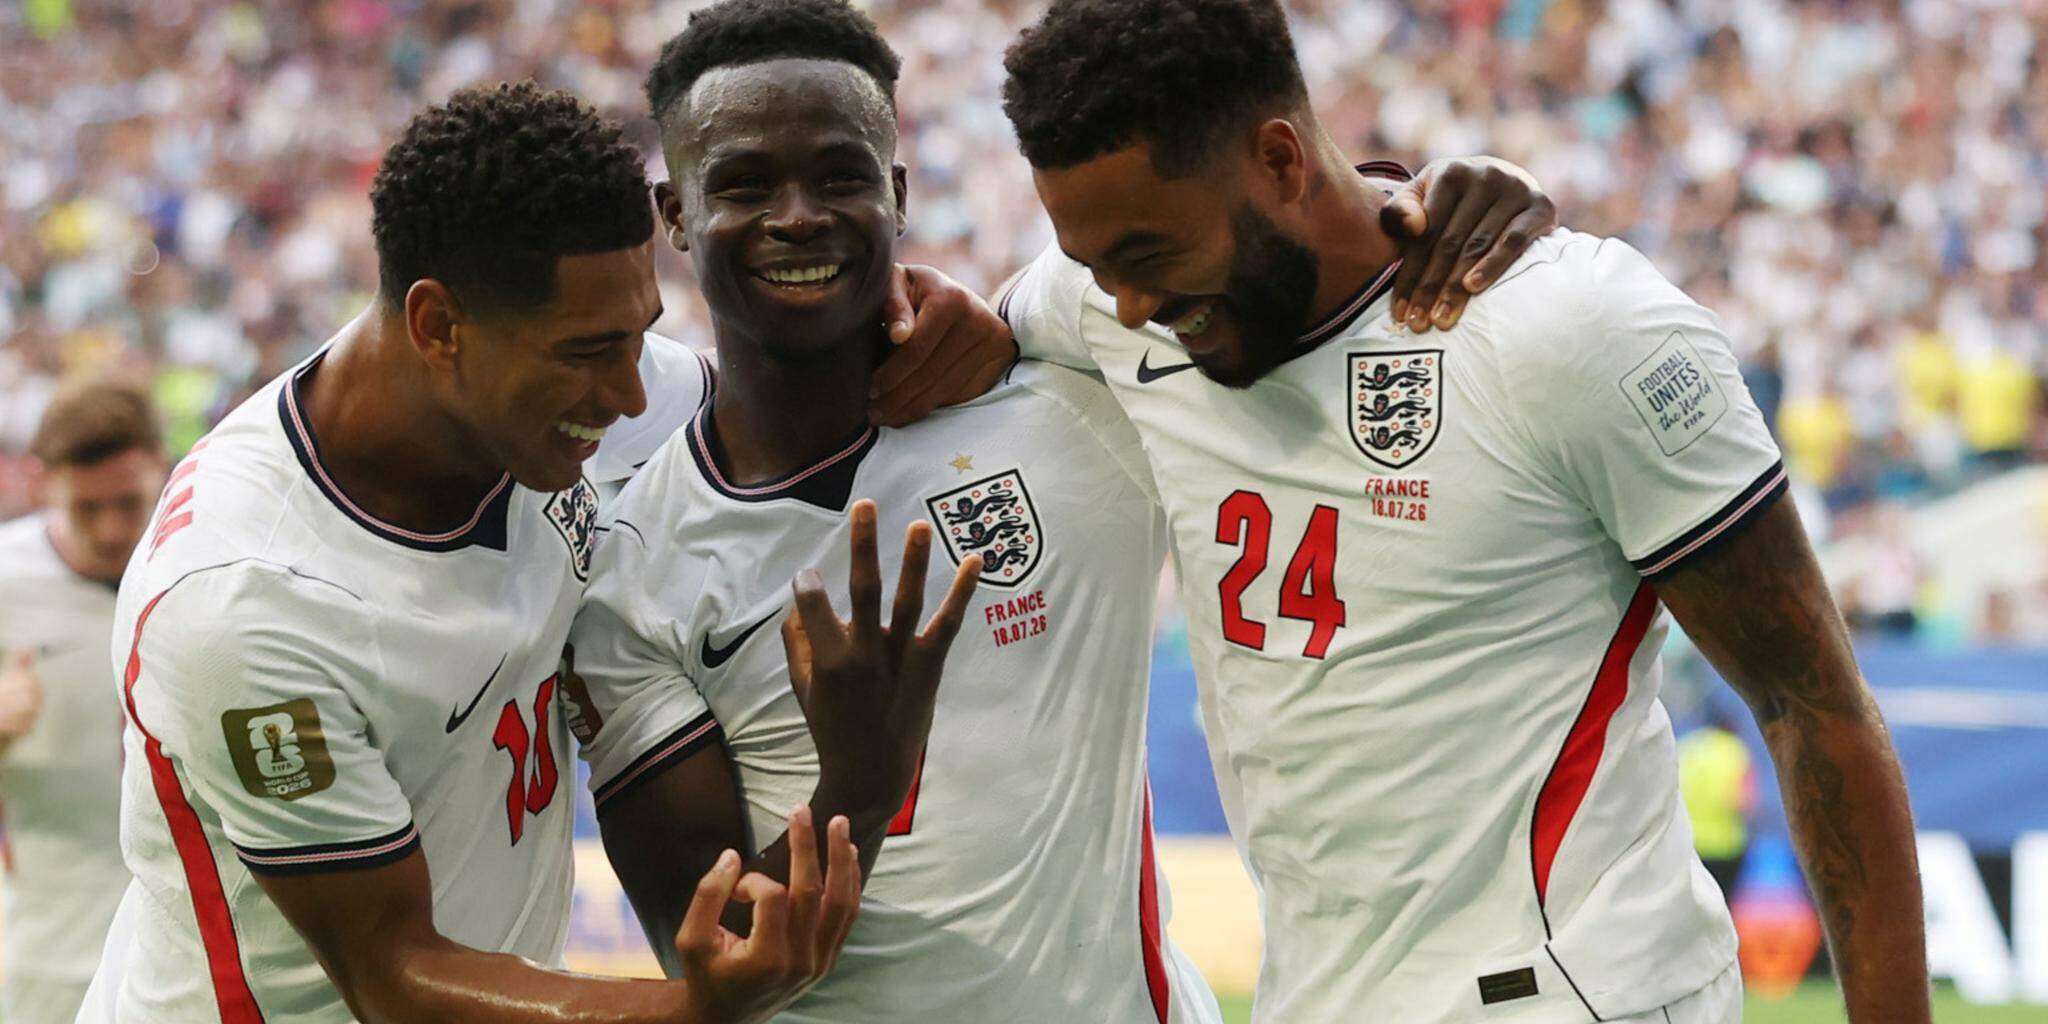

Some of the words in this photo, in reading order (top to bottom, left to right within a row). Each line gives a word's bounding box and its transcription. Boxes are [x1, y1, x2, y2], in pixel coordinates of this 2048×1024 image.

[1637, 349, 1687, 396] FOOTBALL
[1646, 361, 1700, 413] UNITES
[1658, 412, 1681, 431] the
[1678, 377, 1712, 416] World
[1683, 411, 1705, 430] FIFA
[1364, 478, 1430, 498] FRANCE
[1371, 499, 1426, 521] 18.07.26
[1215, 489, 1346, 660] 24
[984, 590, 1047, 625] FRANCE
[992, 614, 1047, 648] 18.07.26
